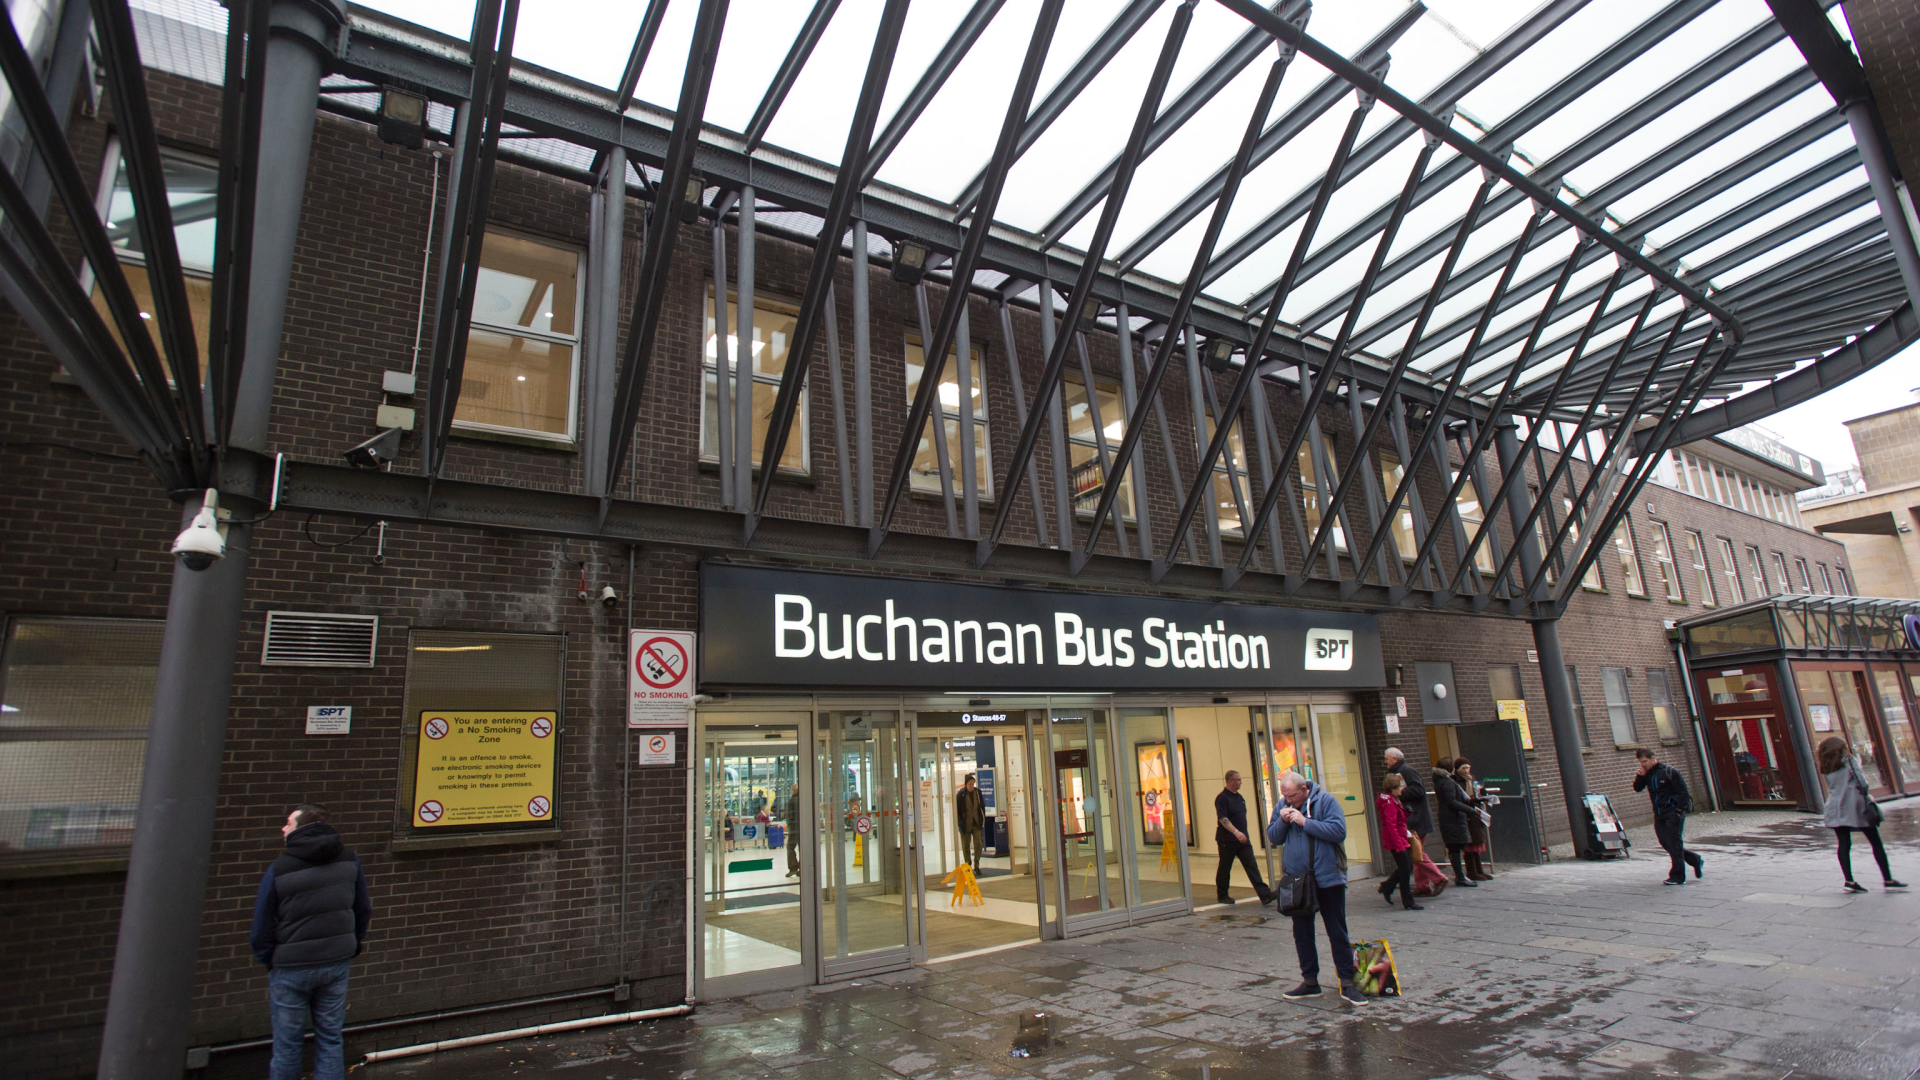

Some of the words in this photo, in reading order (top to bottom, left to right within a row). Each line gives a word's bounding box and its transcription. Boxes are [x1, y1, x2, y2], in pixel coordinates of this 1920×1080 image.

[774, 593, 1044, 665] Buchanan
[1054, 612, 1135, 667] Bus
[1143, 617, 1271, 669] Station
[1312, 638, 1349, 659] SPT
[634, 691, 647, 699] NO
[316, 708, 345, 716] SPT
[454, 717, 470, 725] You
[491, 717, 527, 725] entering
[972, 714, 991, 722] Stances
[467, 726, 481, 734] No
[483, 726, 521, 734] Smoking
[478, 735, 501, 743] Zone
[457, 772, 493, 781] knowingly
